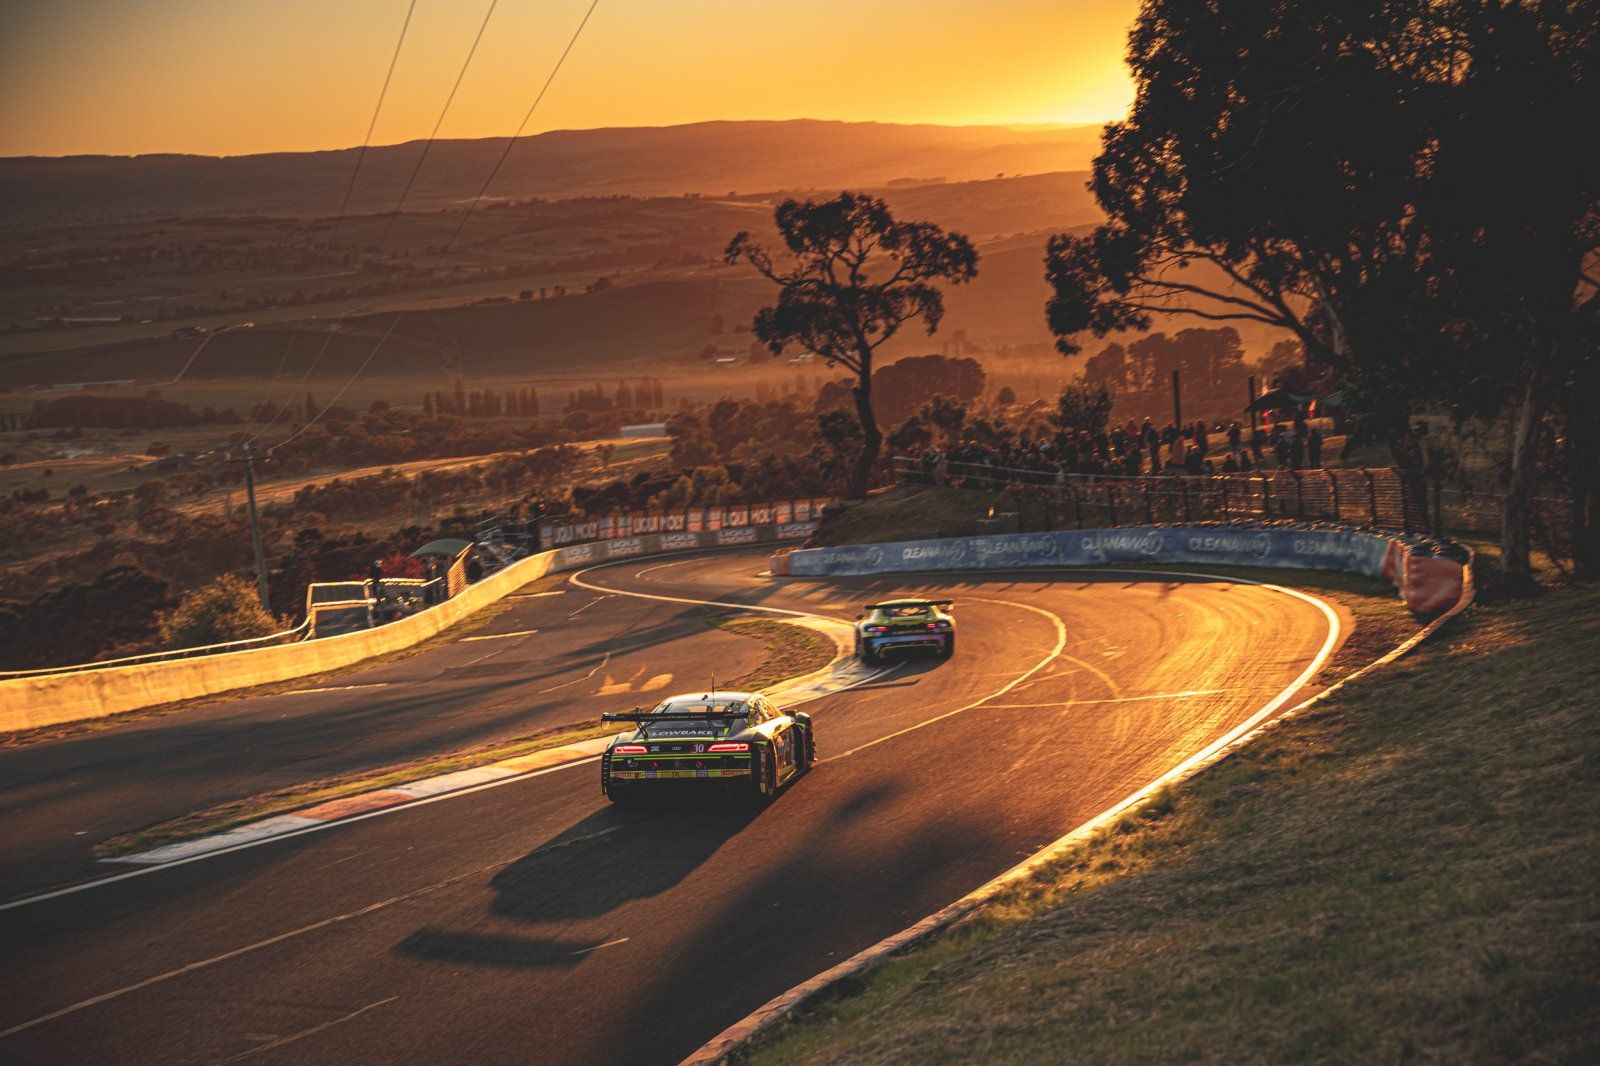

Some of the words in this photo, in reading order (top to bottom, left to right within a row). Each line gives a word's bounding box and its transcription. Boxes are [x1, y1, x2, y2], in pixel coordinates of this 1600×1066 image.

[1081, 536, 1158, 550] CLEANAWAY
[1189, 537, 1271, 551] CLEANAWAY
[694, 743, 704, 753] 10
